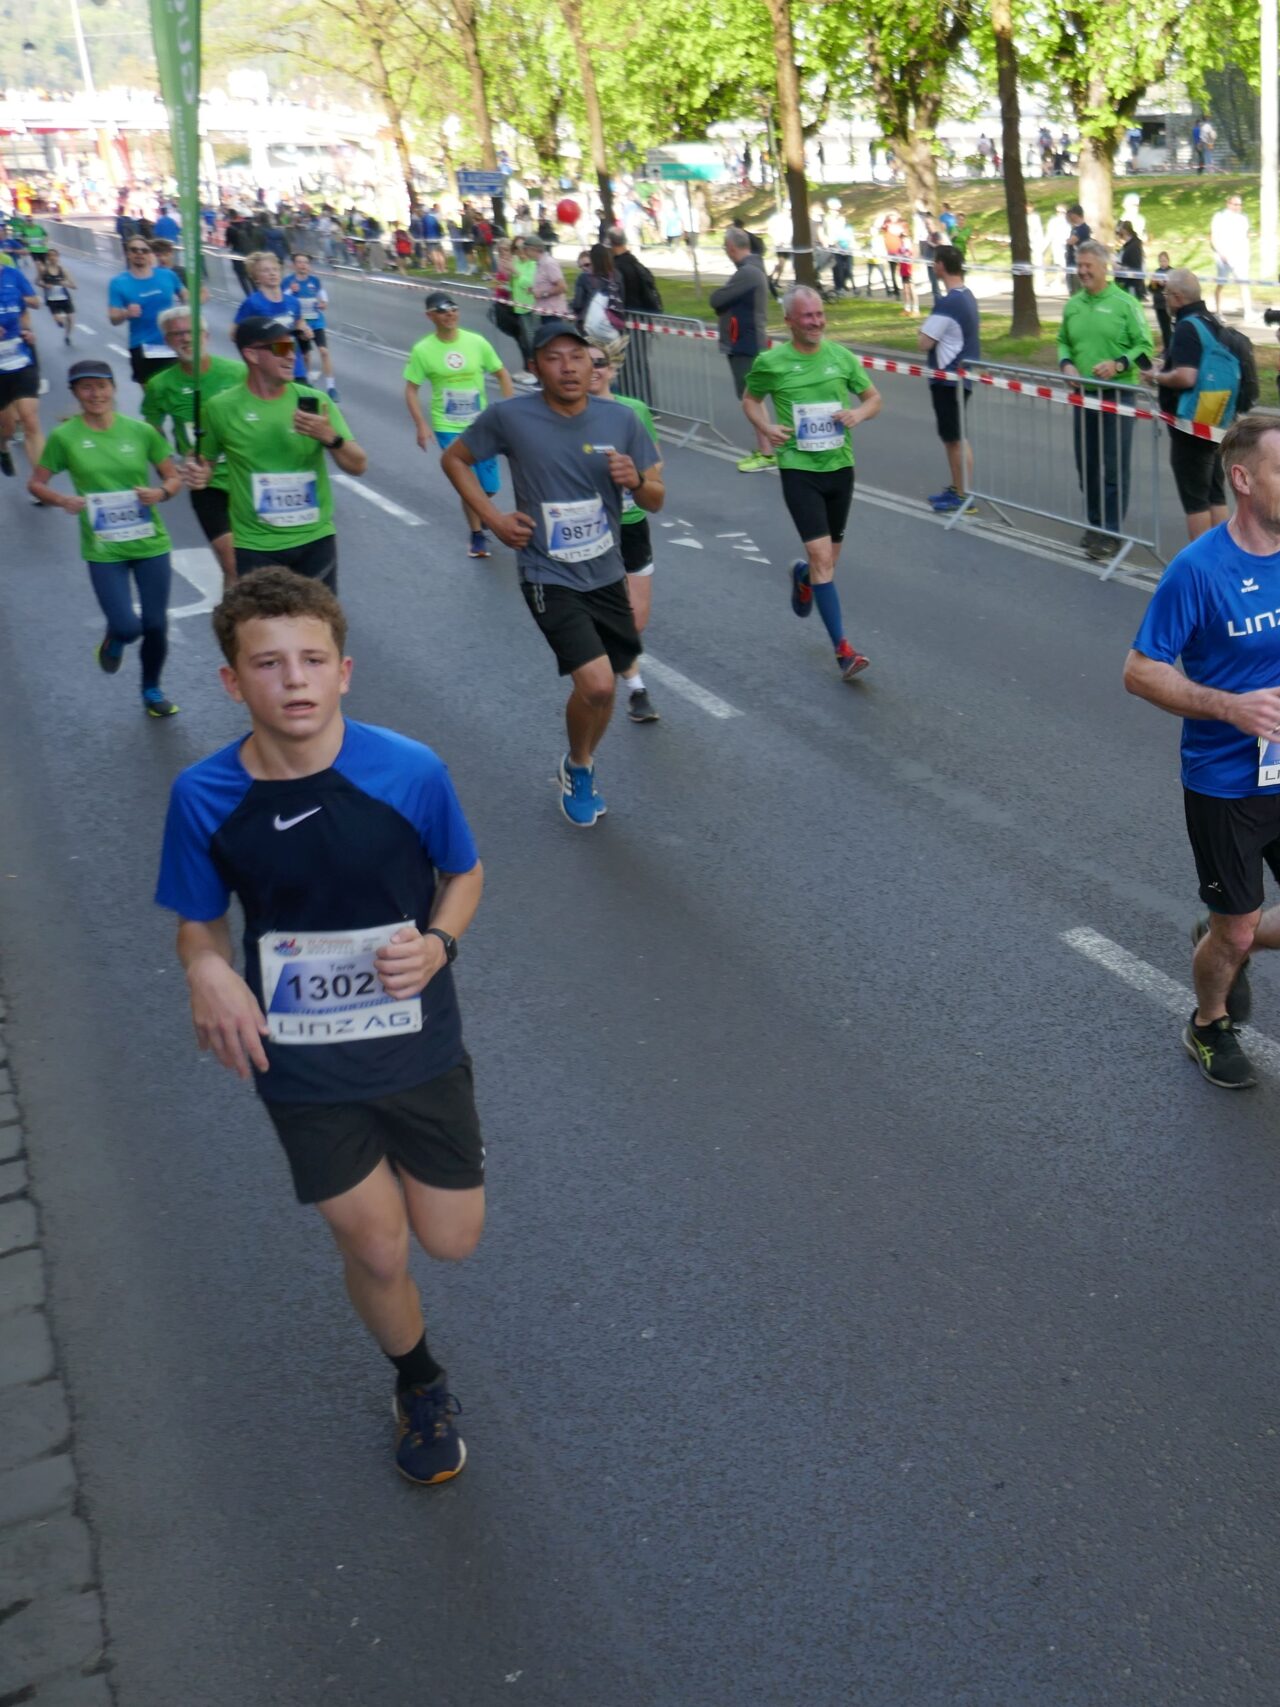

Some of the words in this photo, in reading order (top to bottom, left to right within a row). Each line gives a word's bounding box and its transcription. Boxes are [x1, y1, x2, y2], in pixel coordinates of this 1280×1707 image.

[561, 521, 602, 541] 9877
[287, 971, 387, 1000] 1302
[278, 1018, 355, 1037] LINZ
[363, 1011, 412, 1031] AG
